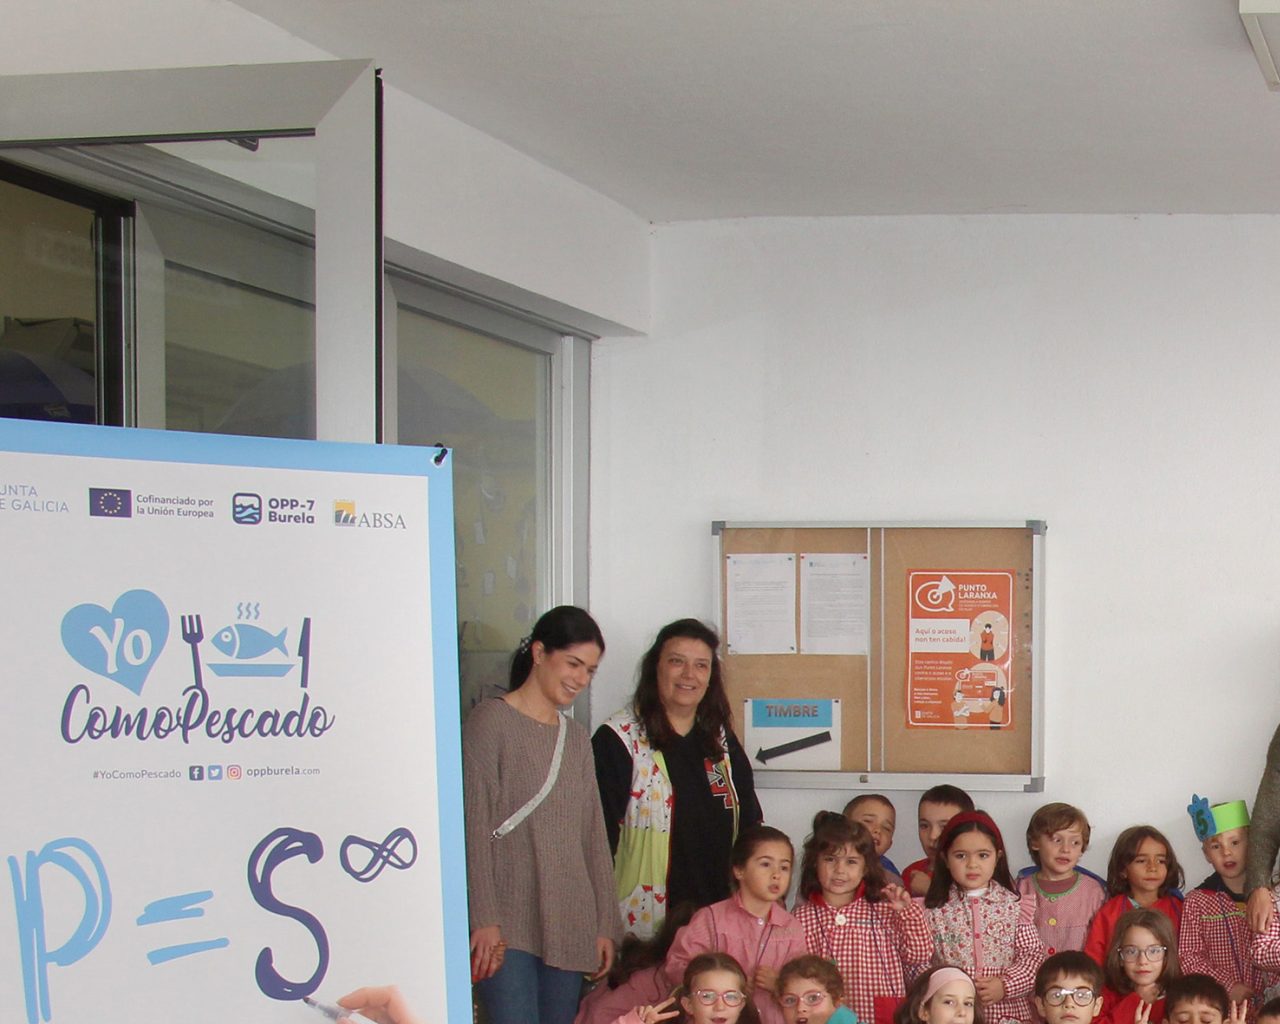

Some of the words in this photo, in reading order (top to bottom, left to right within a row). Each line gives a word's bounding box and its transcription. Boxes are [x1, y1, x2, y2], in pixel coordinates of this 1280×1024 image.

[11, 499, 69, 513] GALICIA
[136, 494, 197, 506] Cofinanciado
[198, 498, 214, 508] por
[268, 498, 315, 511] OPP-7
[136, 505, 144, 515] la
[147, 505, 175, 516] Unión
[177, 508, 214, 518] Europea
[268, 511, 315, 524] Burela
[357, 512, 407, 530] ABSA
[958, 584, 987, 592] PUNTO
[958, 592, 998, 600] LARANXA
[765, 704, 819, 717] TIMBRE
[92, 769, 182, 781] #YoComoPescado
[246, 766, 321, 779] oppburela.com
